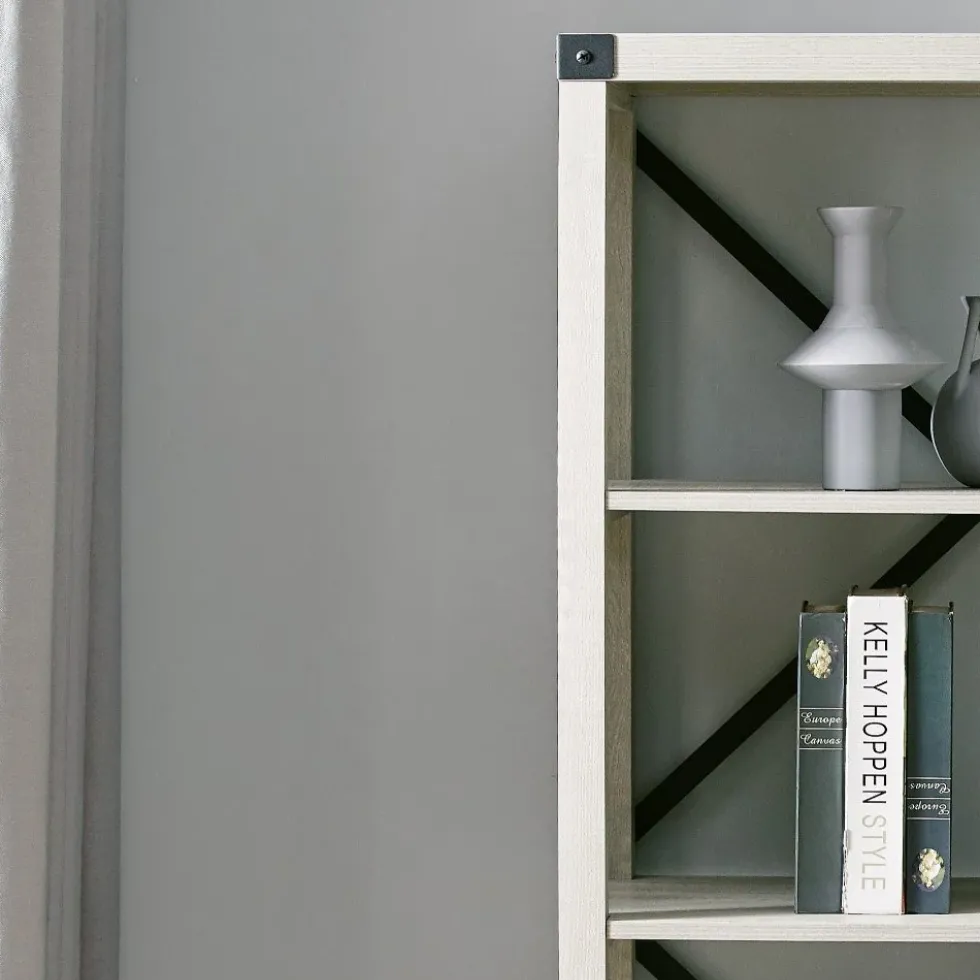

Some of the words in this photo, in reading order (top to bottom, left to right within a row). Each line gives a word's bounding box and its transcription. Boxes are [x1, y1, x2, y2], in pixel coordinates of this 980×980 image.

[863, 621, 888, 695] KELLY
[801, 711, 842, 727] Europe
[801, 733, 842, 746] Canvas
[862, 704, 888, 804] HOPPEN
[910, 782, 950, 795] Canvas
[909, 802, 949, 816] Europe
[861, 814, 886, 890] STYLE
